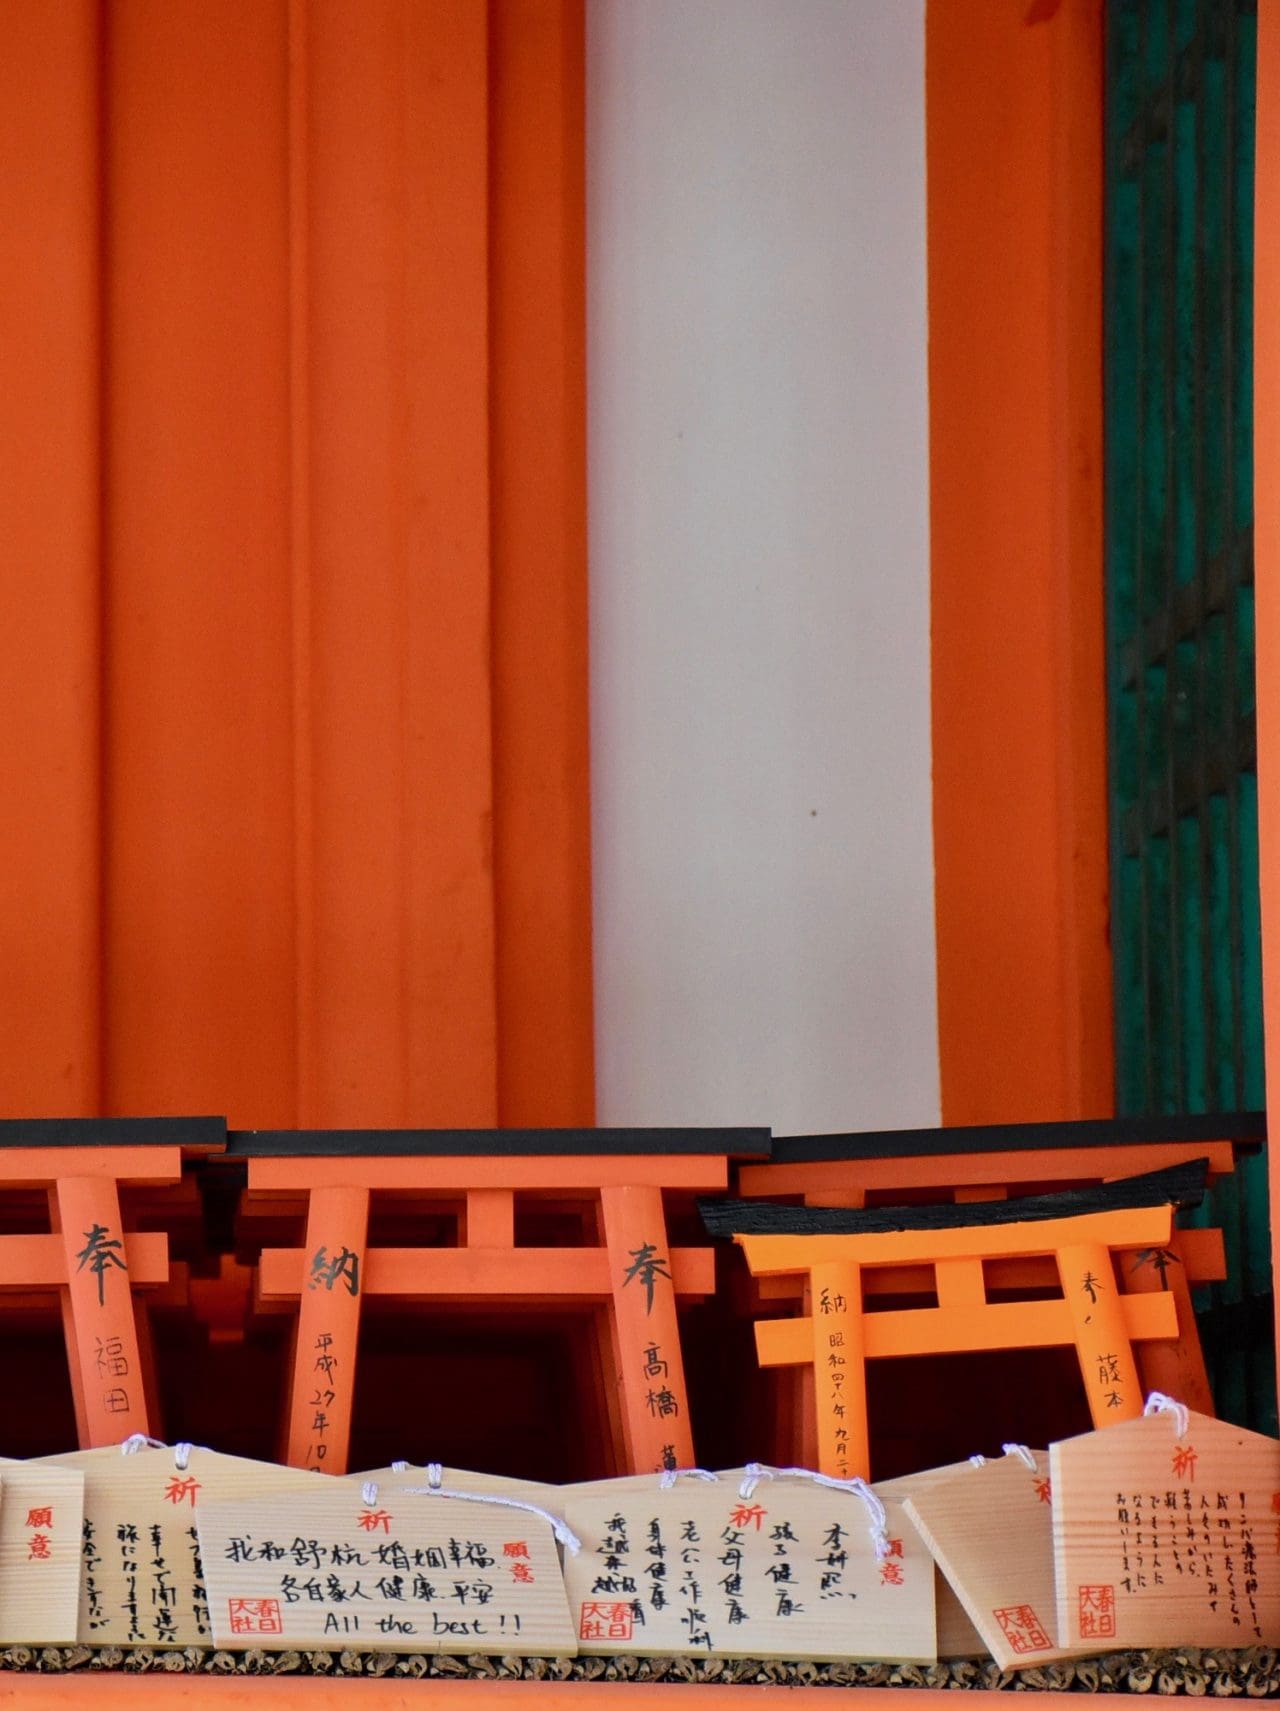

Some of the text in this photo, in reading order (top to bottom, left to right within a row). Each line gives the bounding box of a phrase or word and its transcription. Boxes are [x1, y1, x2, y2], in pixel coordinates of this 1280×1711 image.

[76, 1223, 128, 1306] 奉
[307, 1246, 359, 1296] 納
[623, 1242, 672, 1316] 奉
[820, 1288, 847, 1315] 納
[93, 1336, 130, 1414] 福田
[1171, 1446, 1197, 1483] 祈
[164, 1476, 202, 1508] 祈
[25, 1506, 55, 1561] 願意
[357, 1509, 394, 1535] 祈
[729, 1504, 767, 1531] 祈
[324, 1612, 360, 1635] All
[375, 1614, 417, 1636] the
[432, 1612, 488, 1635] best
